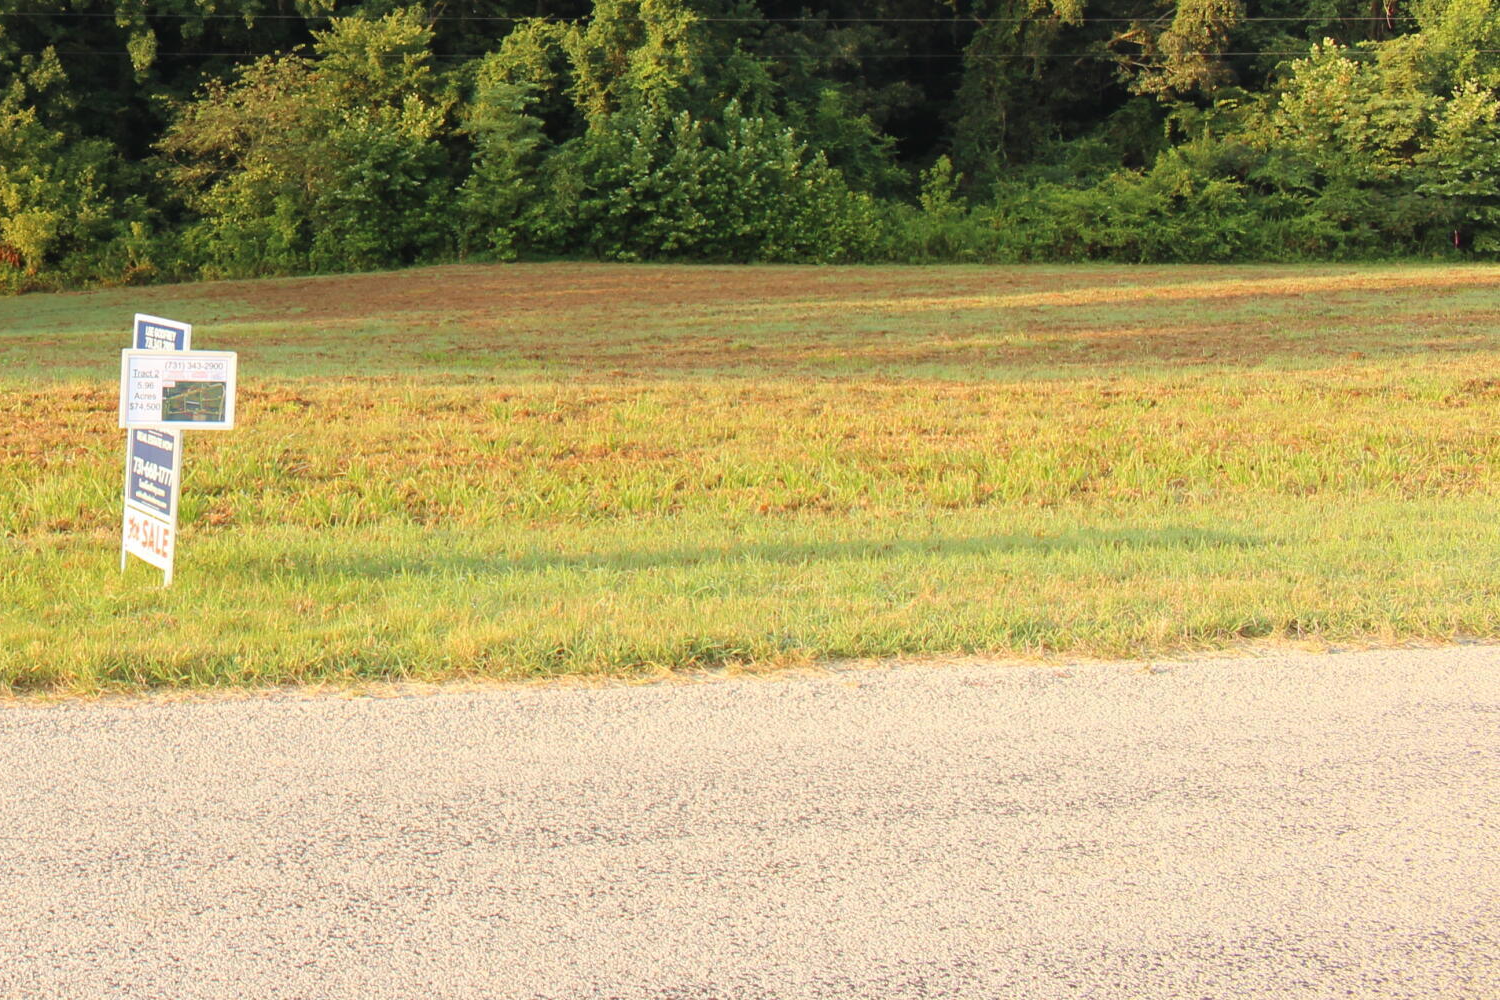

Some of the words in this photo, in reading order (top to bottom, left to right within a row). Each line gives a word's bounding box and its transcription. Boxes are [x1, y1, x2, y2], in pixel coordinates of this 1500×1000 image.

[164, 361, 185, 370] (731)
[187, 361, 224, 371] 343-2900
[132, 369, 153, 378] Tract
[154, 369, 160, 378] 2
[134, 392, 156, 400] Acres
[129, 403, 160, 411] $74,500
[141, 519, 170, 559] SALE
